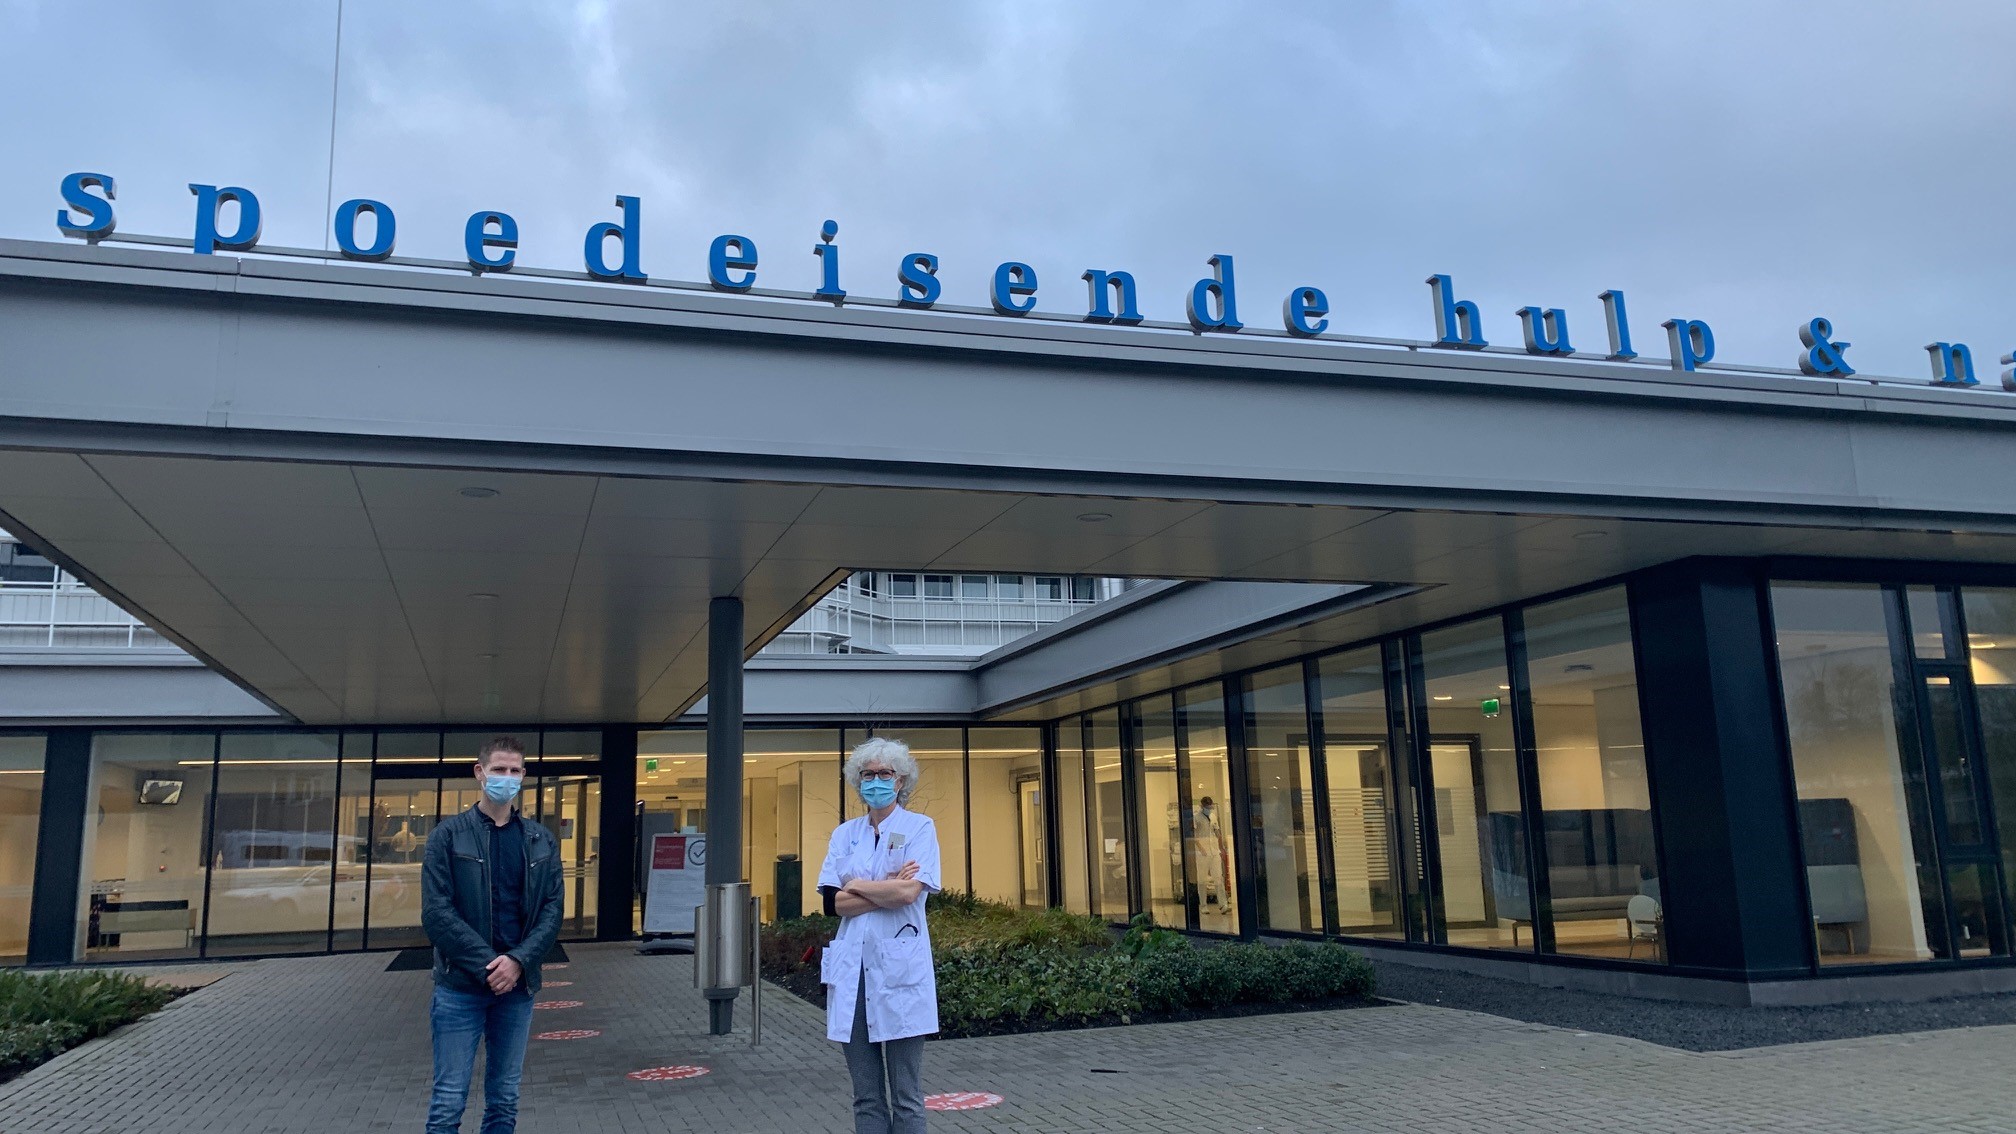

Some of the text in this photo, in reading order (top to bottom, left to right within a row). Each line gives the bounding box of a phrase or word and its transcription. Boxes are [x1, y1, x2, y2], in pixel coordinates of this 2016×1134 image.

[57, 171, 2016, 393] spoedeisende hulp & n
